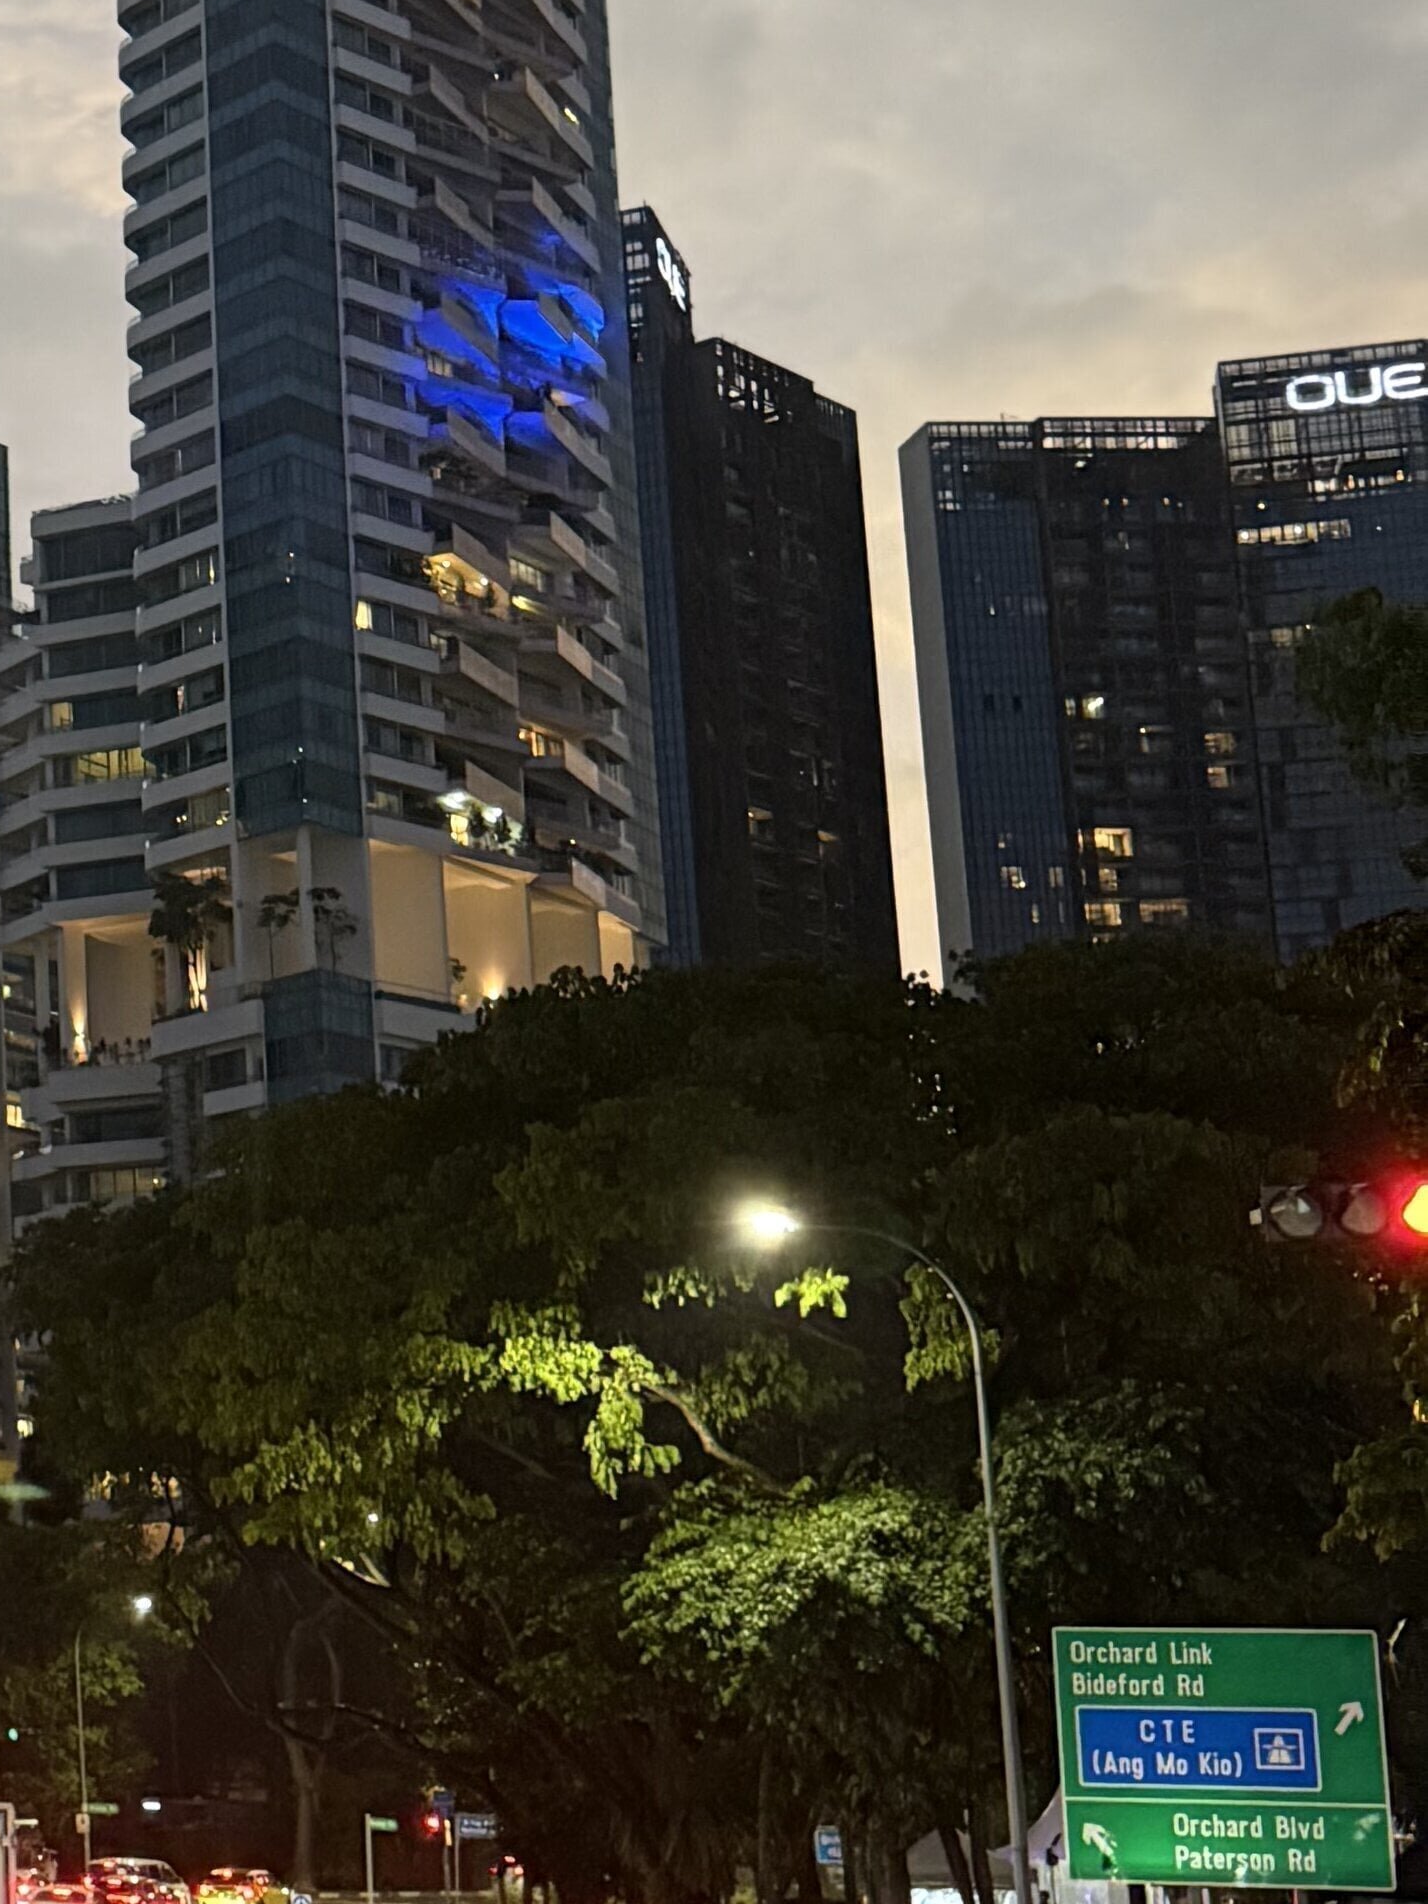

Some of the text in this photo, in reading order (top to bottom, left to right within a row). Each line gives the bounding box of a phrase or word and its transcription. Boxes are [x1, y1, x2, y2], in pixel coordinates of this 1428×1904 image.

[1285, 361, 1428, 411] OUE
[1069, 1640, 1213, 1665] Orchard Link
[1072, 1671, 1205, 1697] Bideford Rd
[1092, 1749, 1243, 1780] (Ang Mo Kio)
[1173, 1812, 1325, 1840] Orchard Blvd
[1174, 1845, 1316, 1873] Paterson Rd
